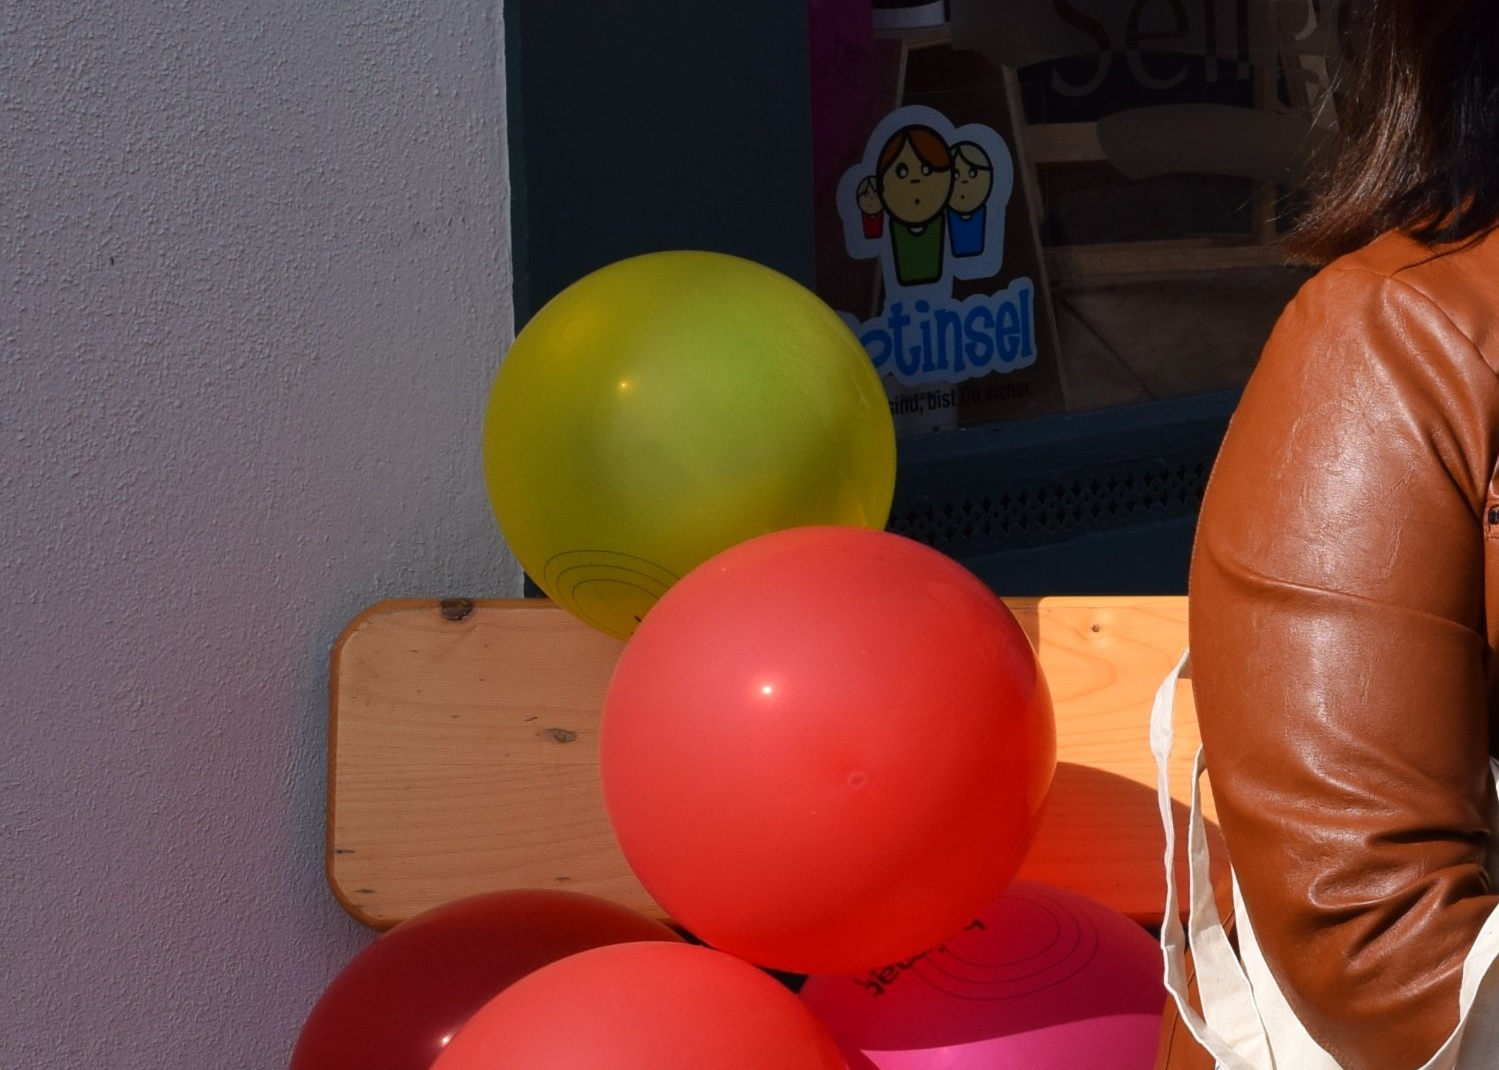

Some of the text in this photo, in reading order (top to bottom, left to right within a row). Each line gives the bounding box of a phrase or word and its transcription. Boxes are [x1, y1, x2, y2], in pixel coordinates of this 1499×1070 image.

[860, 289, 1032, 377] otinsel
[927, 390, 957, 410] bist
[960, 386, 981, 405] Du
[985, 380, 1034, 403] sicher.
